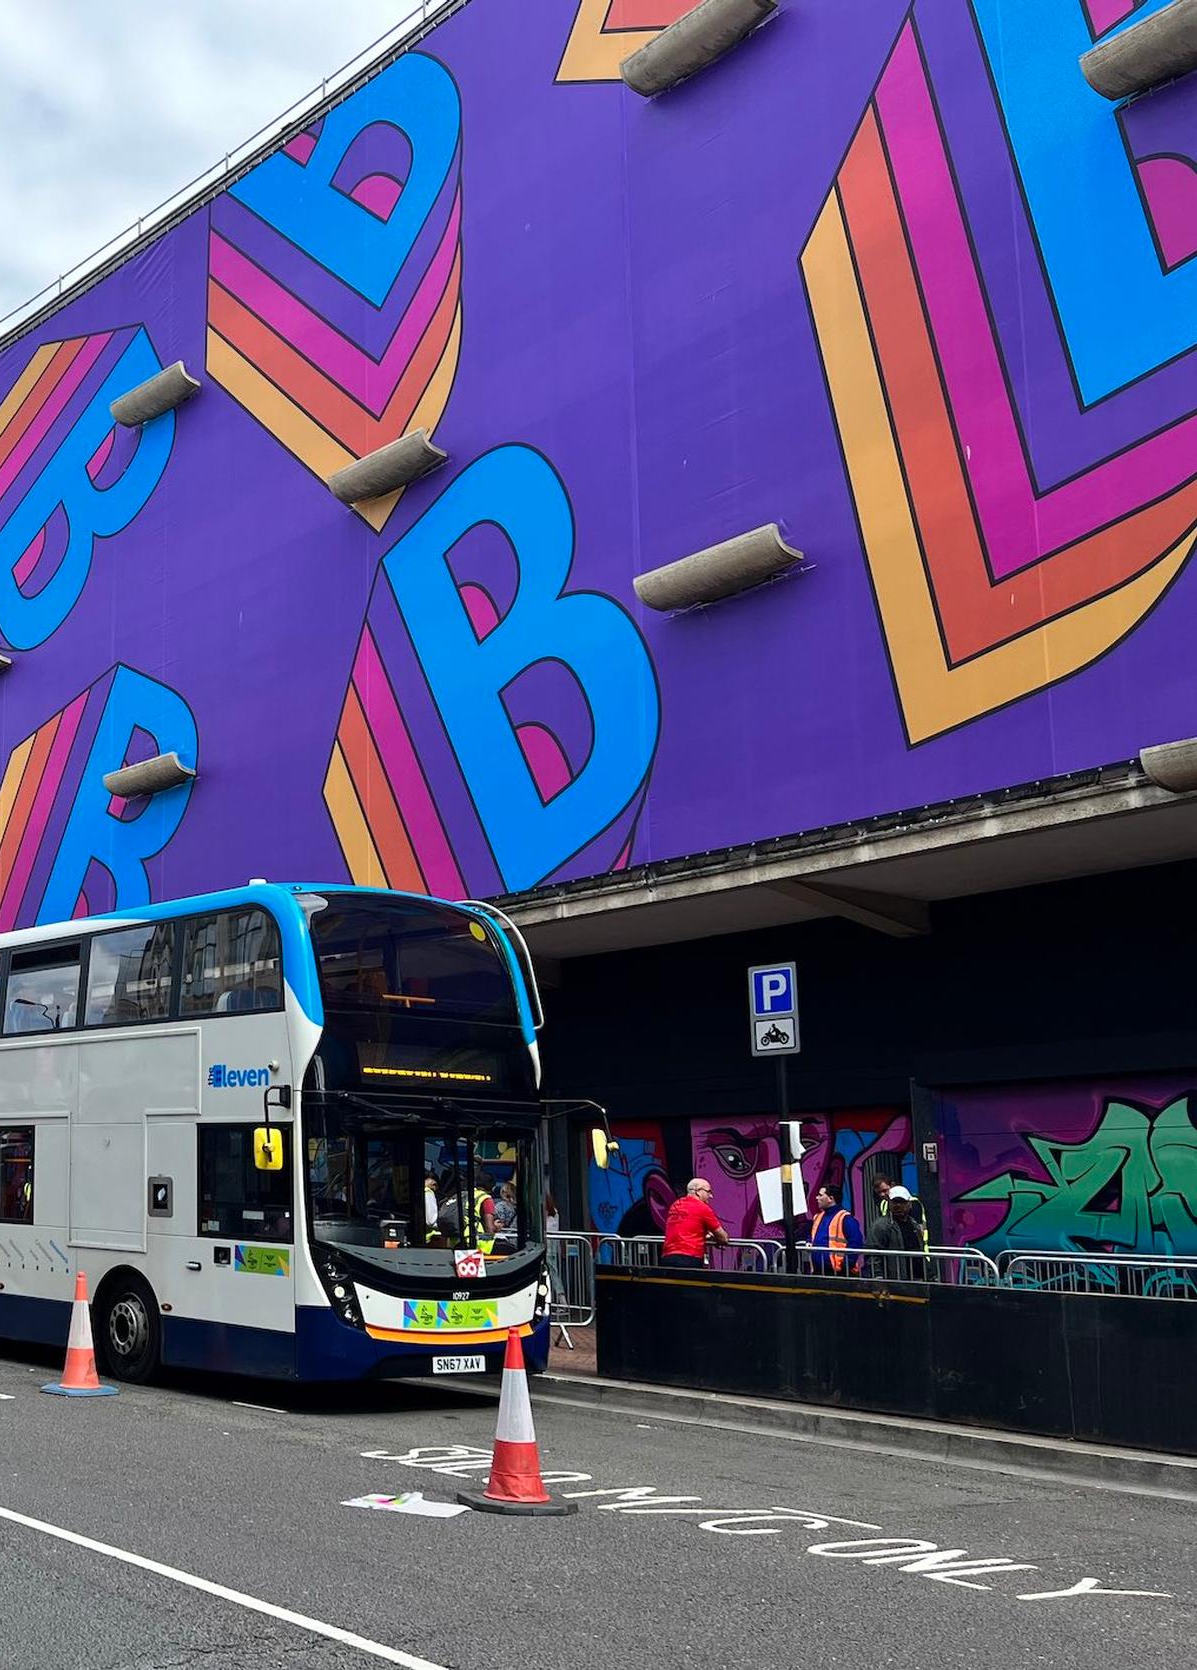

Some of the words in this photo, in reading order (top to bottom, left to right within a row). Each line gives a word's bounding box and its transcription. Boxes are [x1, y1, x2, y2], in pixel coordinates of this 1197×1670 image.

[762, 973, 787, 1011] P
[453, 1291, 470, 1301] 10927
[437, 1358, 461, 1371] SN67
[463, 1357, 481, 1370] XAV
[807, 1538, 1174, 1601] ONLY
